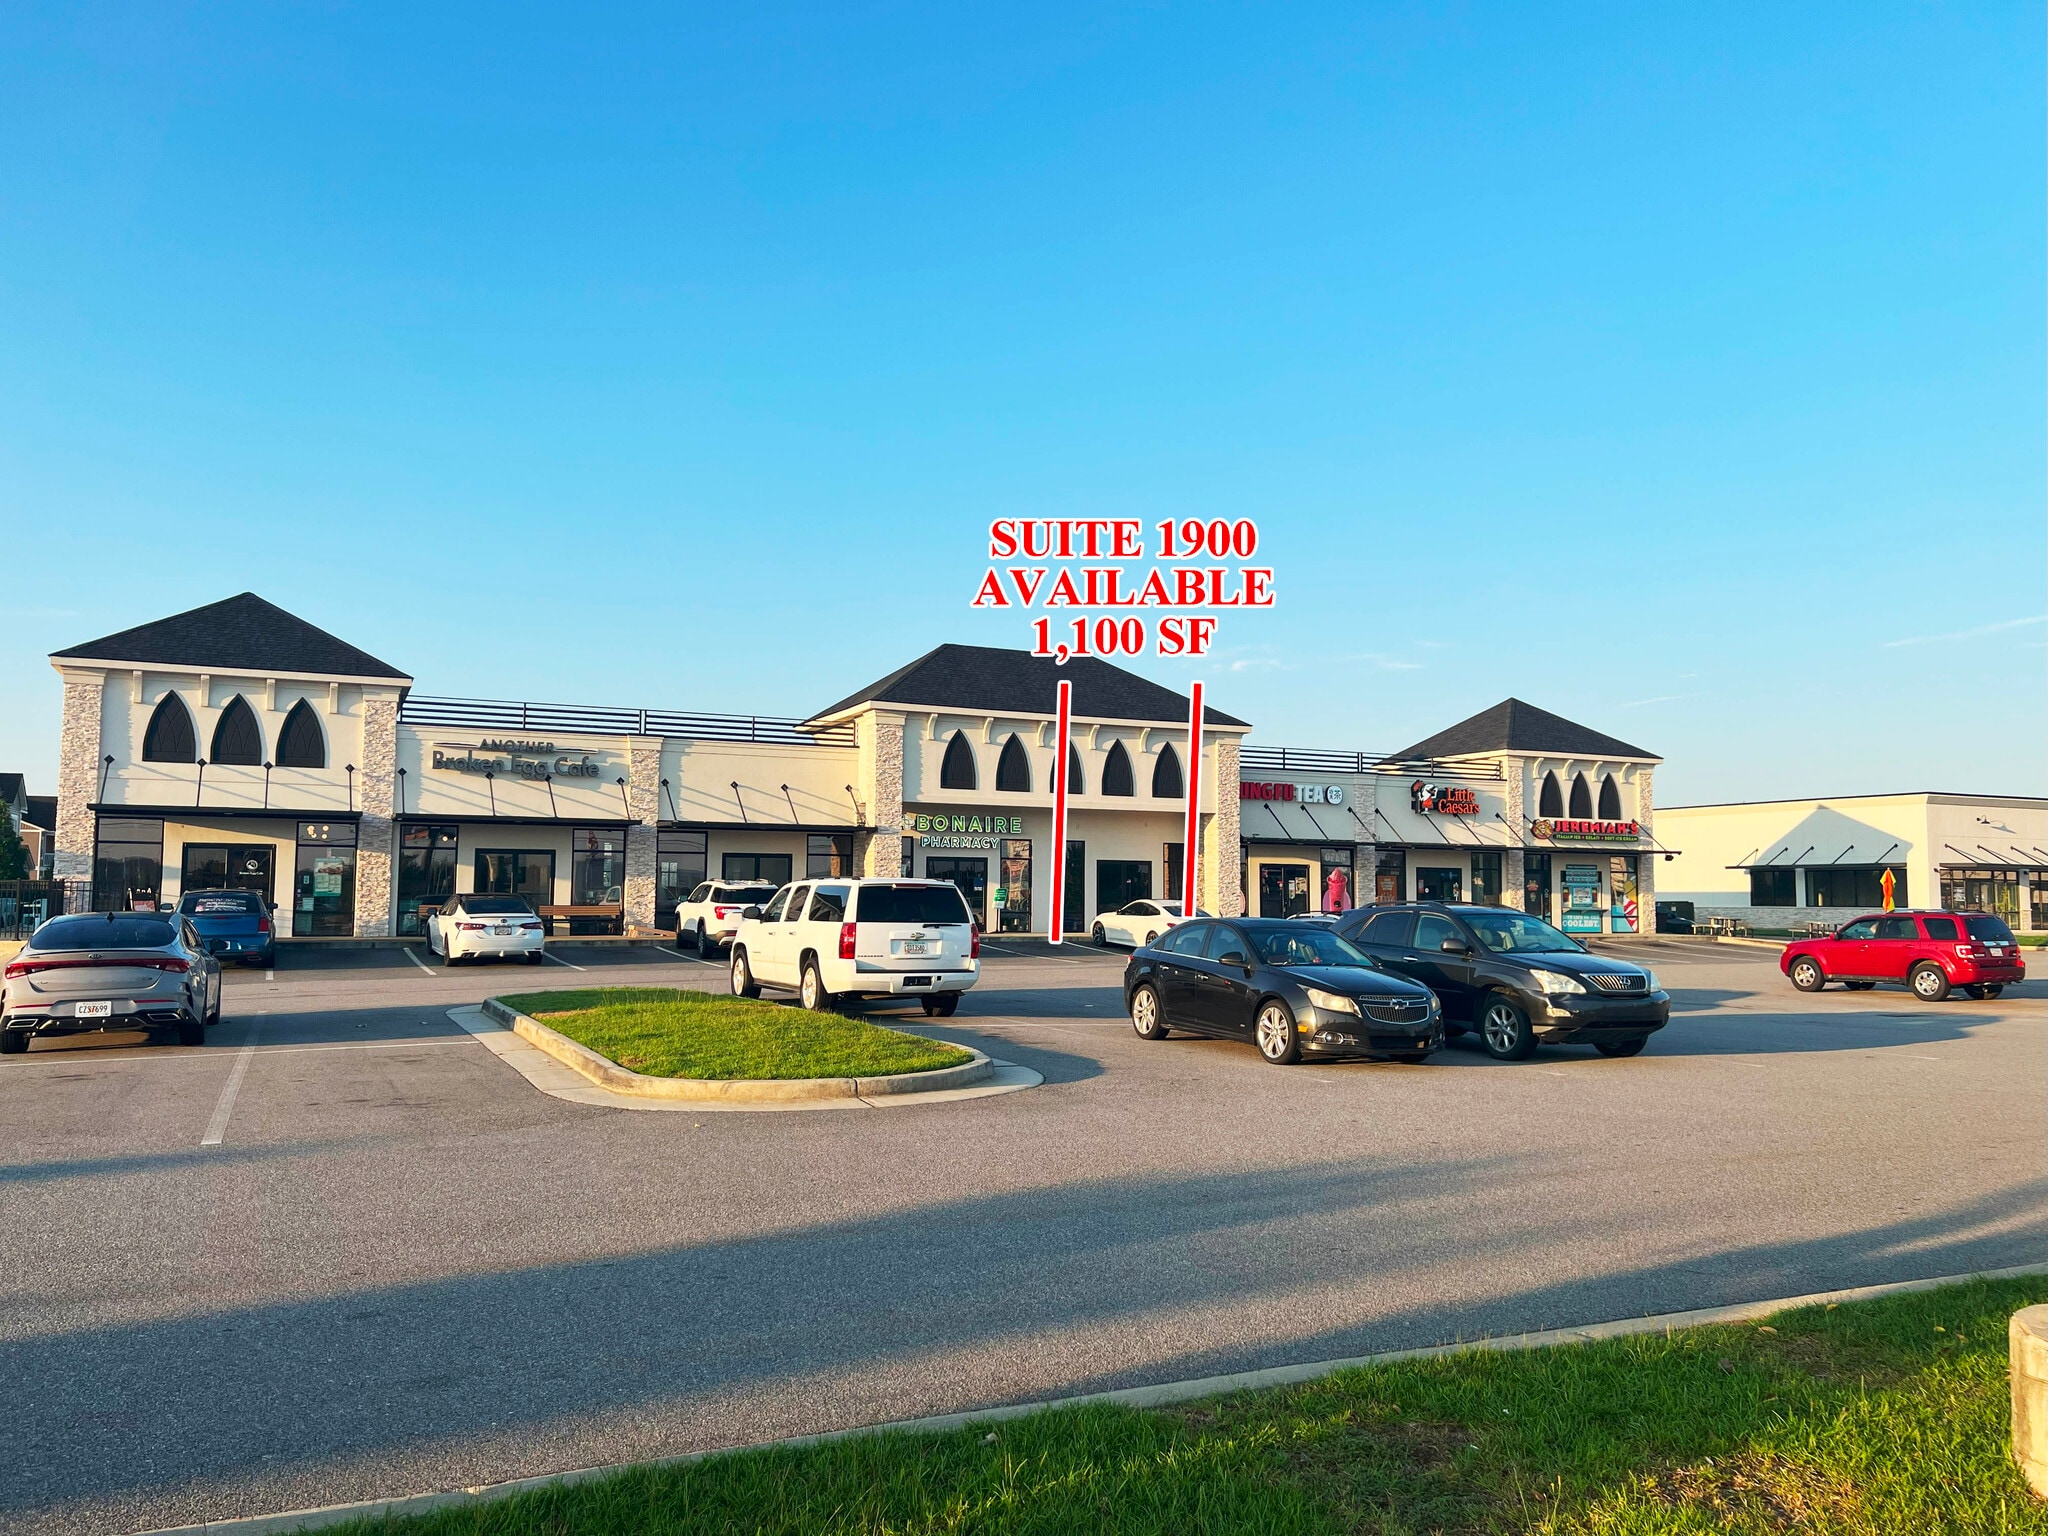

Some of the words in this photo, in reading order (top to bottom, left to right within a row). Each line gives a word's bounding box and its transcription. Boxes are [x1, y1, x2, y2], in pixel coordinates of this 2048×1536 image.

[478, 738, 556, 754] ANOTHER
[432, 750, 505, 773] Broken
[510, 754, 549, 780] Egg
[554, 756, 600, 778] Cafe
[1239, 781, 1273, 801] UNG
[1273, 783, 1295, 802] FU
[1295, 784, 1324, 804] TEA
[1446, 786, 1476, 803] Little
[1438, 799, 1481, 814] Caesars
[916, 814, 1022, 834] BONAIRE
[1555, 820, 1639, 835] JEREMIAH'S
[920, 836, 1000, 849] PHARMACY
